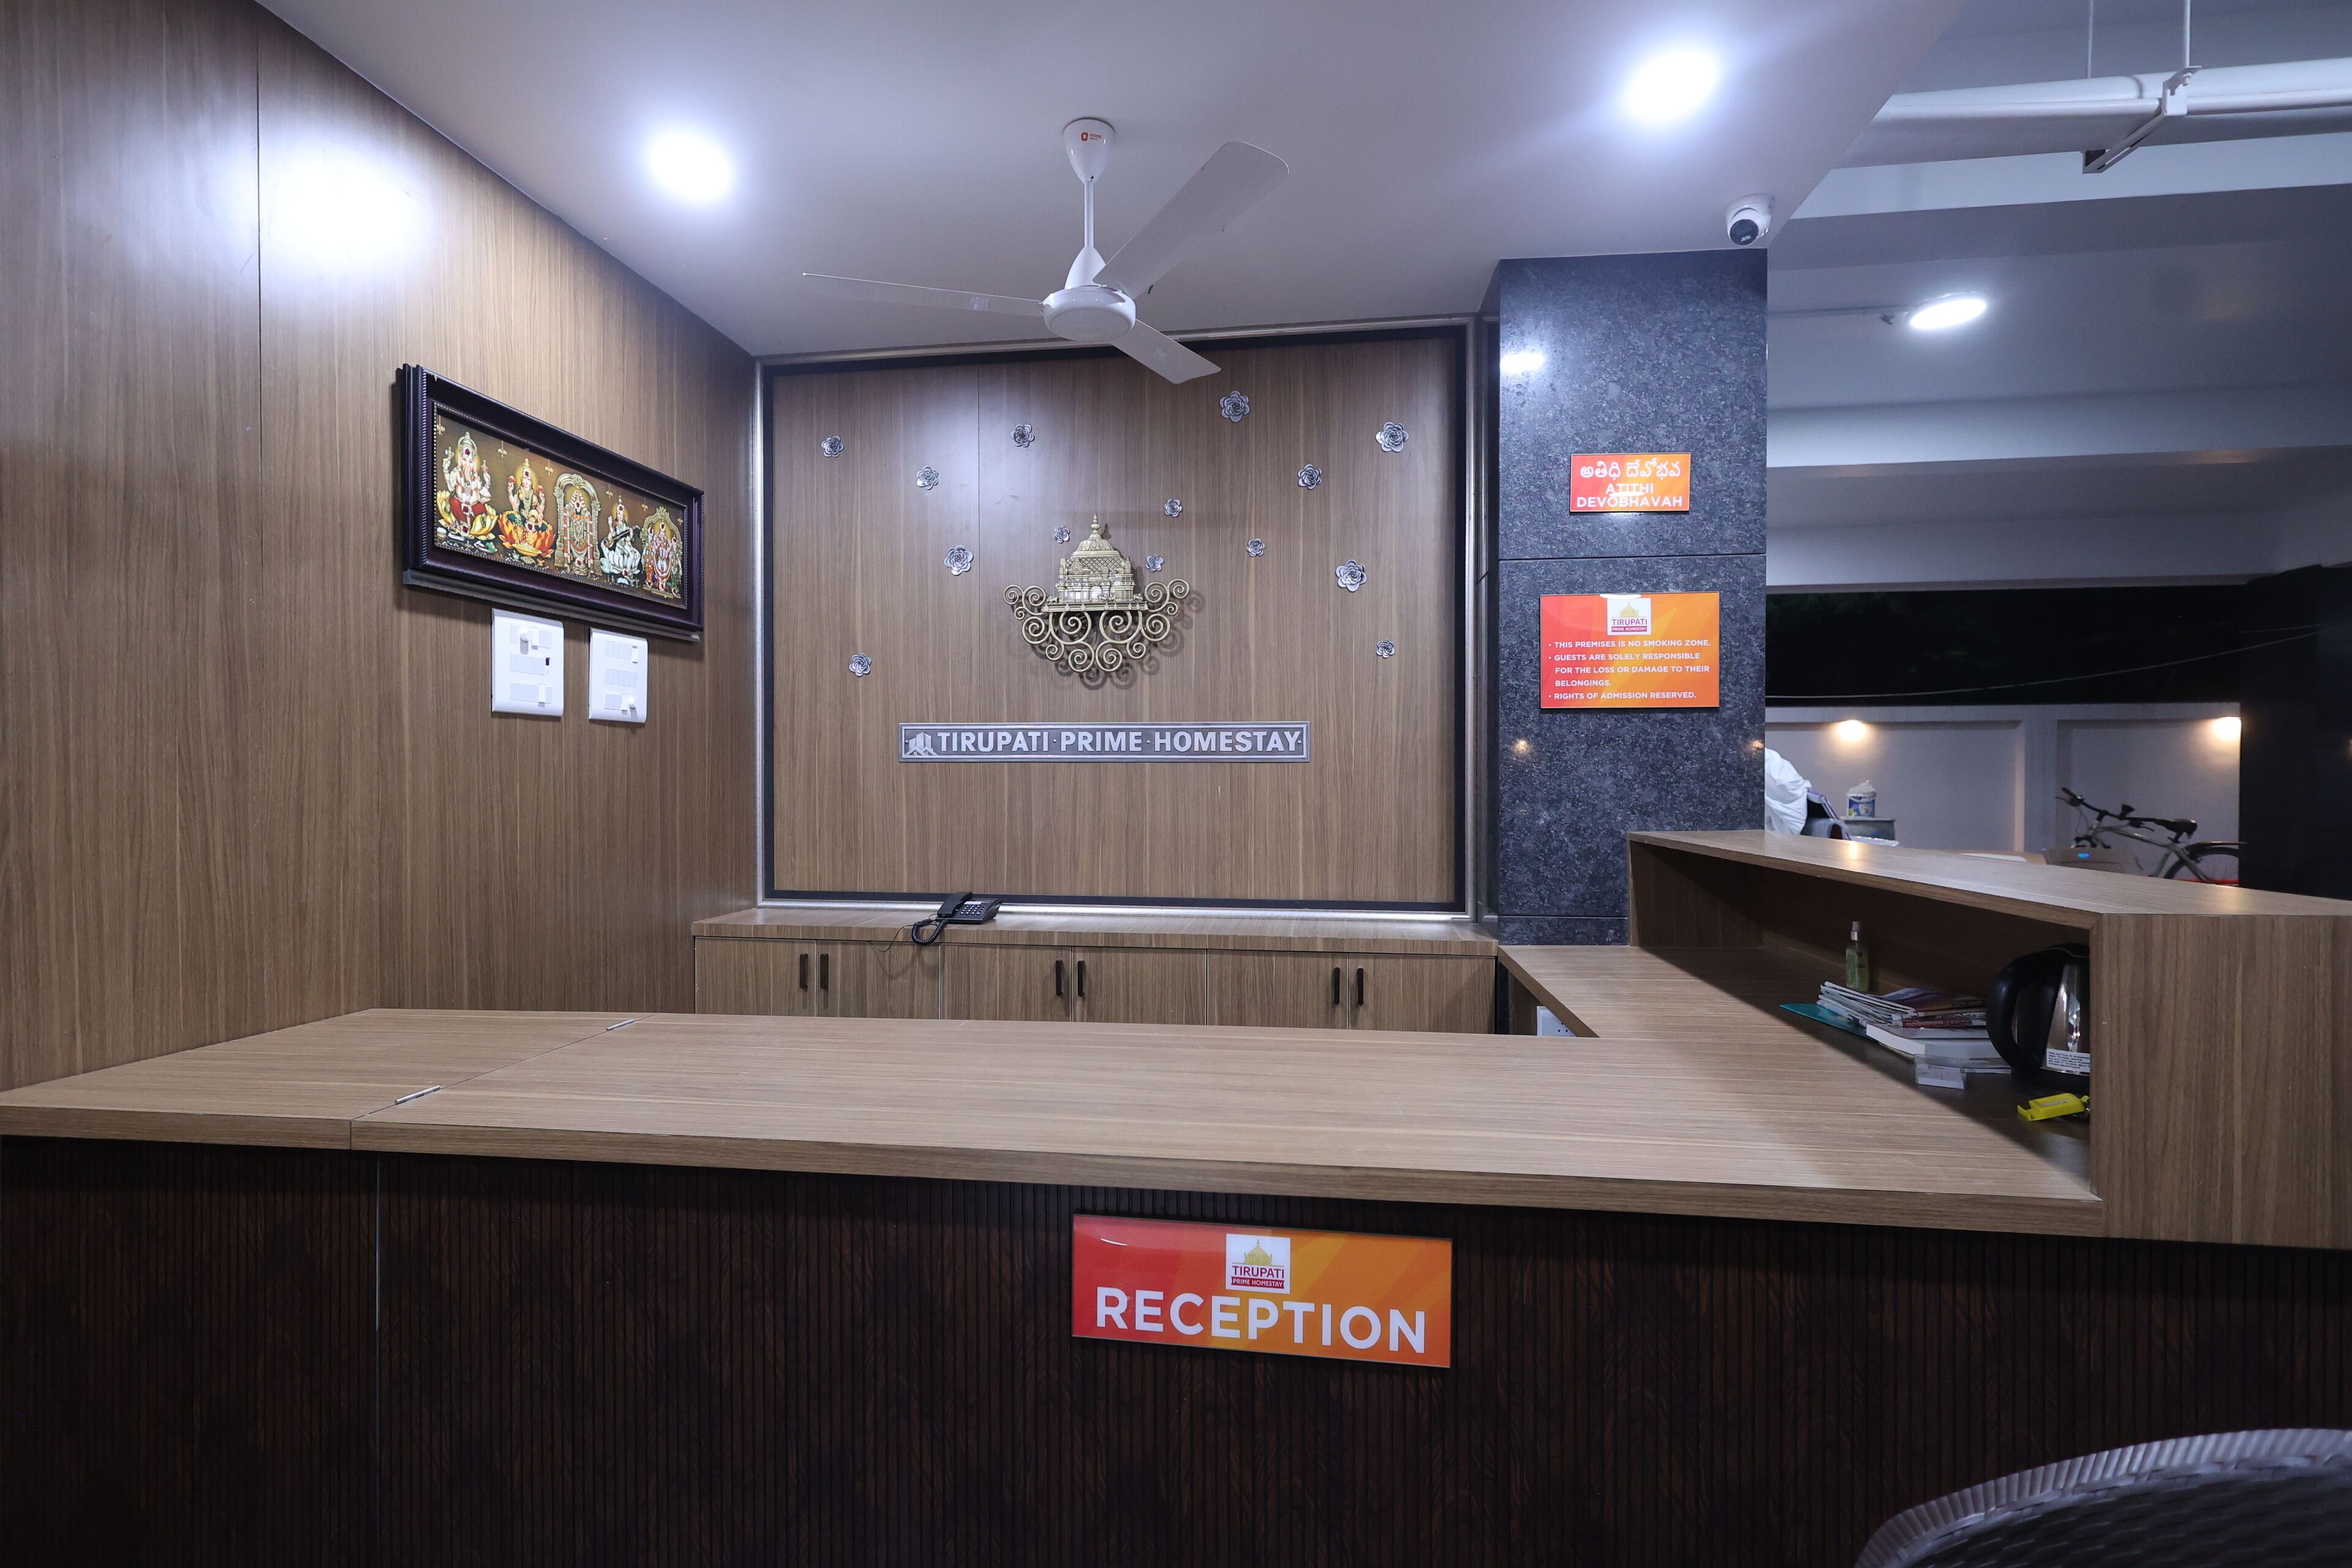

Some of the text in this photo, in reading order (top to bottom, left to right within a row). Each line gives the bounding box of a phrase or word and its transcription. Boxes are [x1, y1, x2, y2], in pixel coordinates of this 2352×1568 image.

[1605, 483, 1654, 494] ATITHI
[1577, 496, 1683, 508] DEVOBHAVAH
[938, 730, 1301, 752] TIRUPATI PRIME HOMESTAY
[1232, 1265, 1284, 1278] TIRUPATI
[1096, 1286, 1425, 1354] RECEPTION
